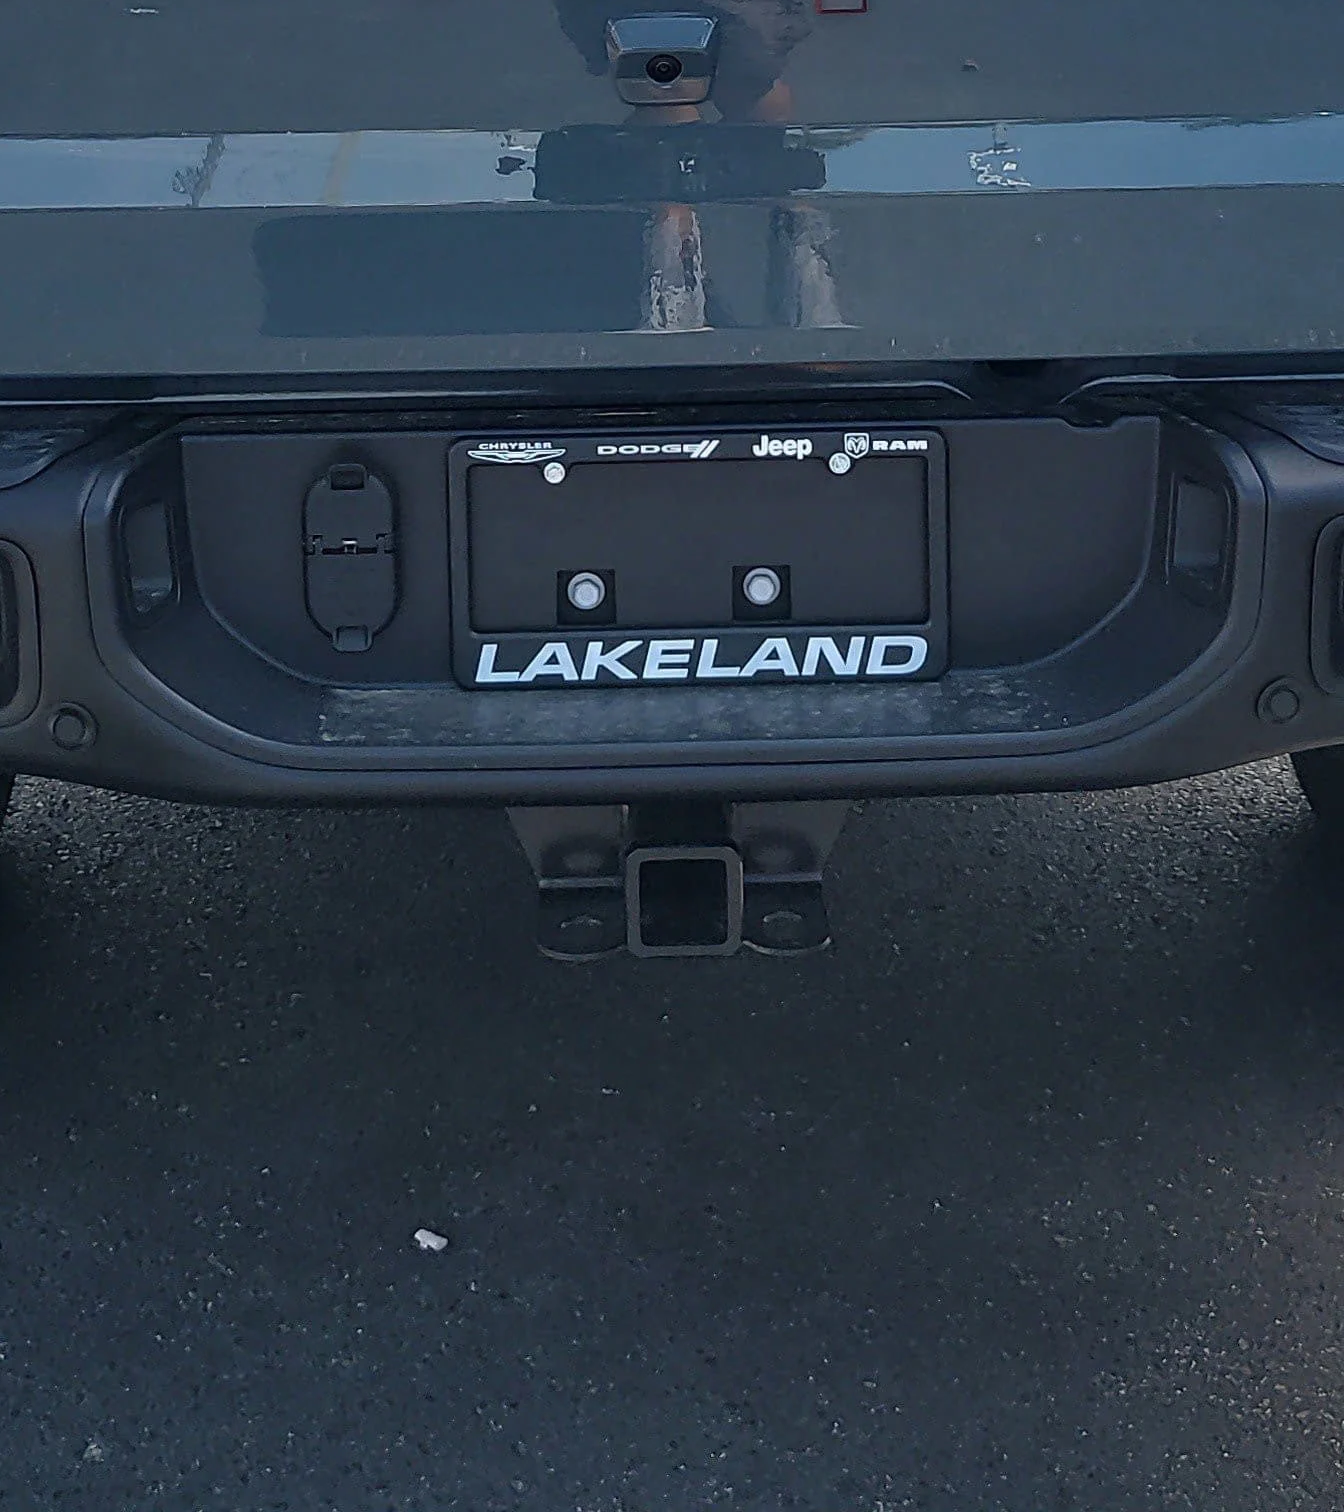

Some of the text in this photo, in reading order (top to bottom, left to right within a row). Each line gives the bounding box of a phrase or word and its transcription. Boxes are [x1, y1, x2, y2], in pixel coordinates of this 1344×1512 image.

[478, 434, 928, 460] CHRYSLER DODGE Jeep RAM
[474, 635, 928, 683] LAKELAND
